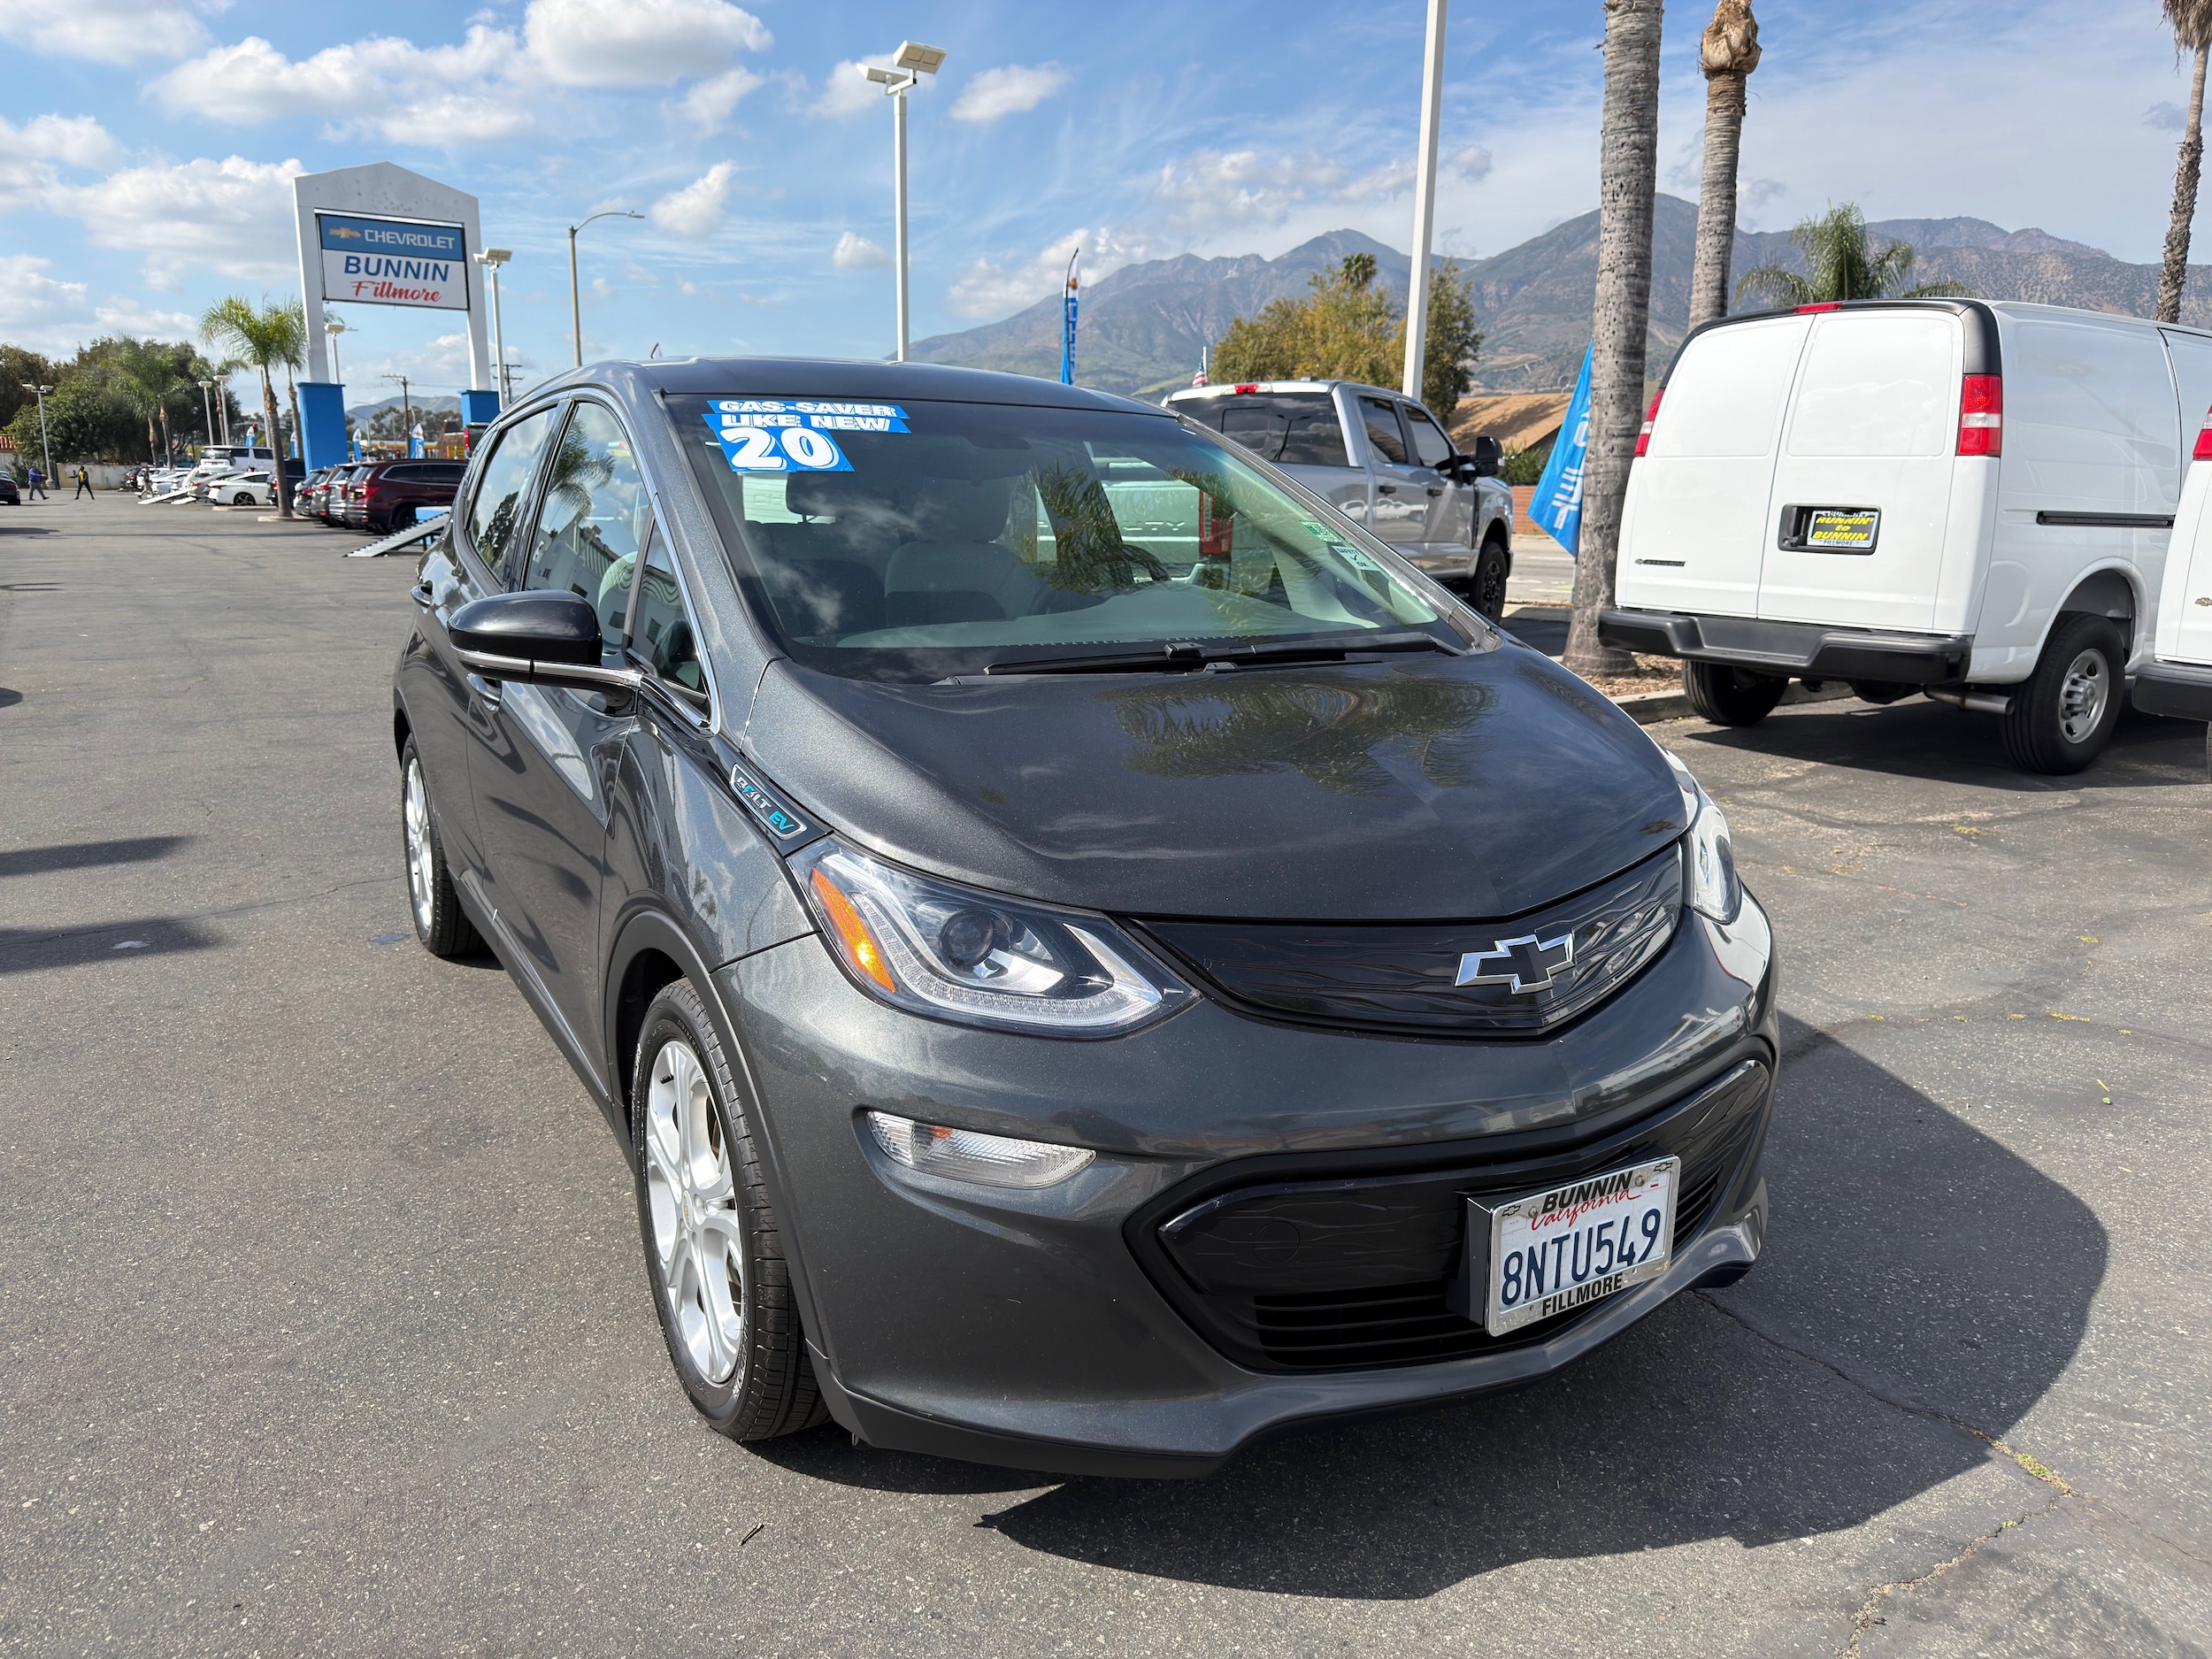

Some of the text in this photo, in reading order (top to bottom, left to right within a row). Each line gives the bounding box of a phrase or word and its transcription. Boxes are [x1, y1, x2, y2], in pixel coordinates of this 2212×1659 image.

[365, 229, 455, 250] CHEVROLET
[344, 255, 449, 282] BUNNIN
[350, 280, 442, 303] Fillmore
[718, 401, 897, 418] GAS-SAVER
[721, 414, 891, 432] LIKE NEW
[719, 426, 840, 471] 20
[1812, 531, 1869, 541] BUNNIN
[736, 776, 795, 831] BOLT EV
[1541, 1171, 1633, 1213] BUNNIN
[1501, 1208, 1662, 1306] 8NTU549
[1542, 1272, 1623, 1317] FILLMORE
